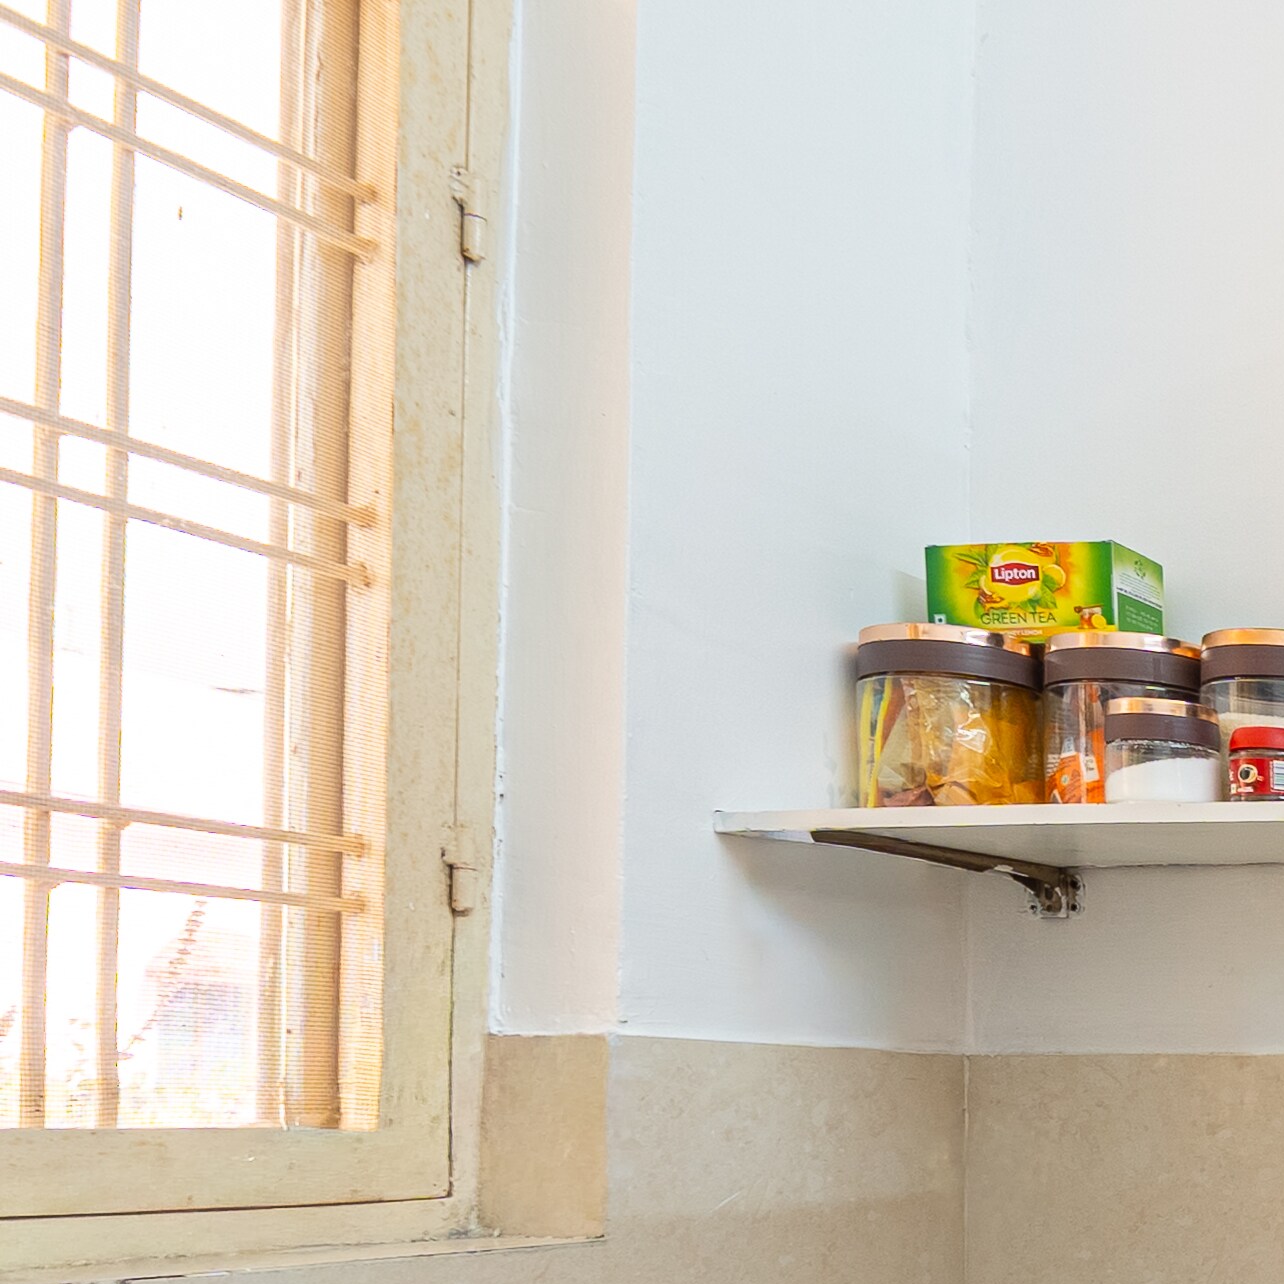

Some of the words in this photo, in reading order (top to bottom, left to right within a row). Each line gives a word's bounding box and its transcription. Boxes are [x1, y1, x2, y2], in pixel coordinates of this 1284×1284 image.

[993, 567, 1036, 583] Lipton
[980, 612, 1028, 625] GREEN
[1029, 611, 1057, 624] TEA
